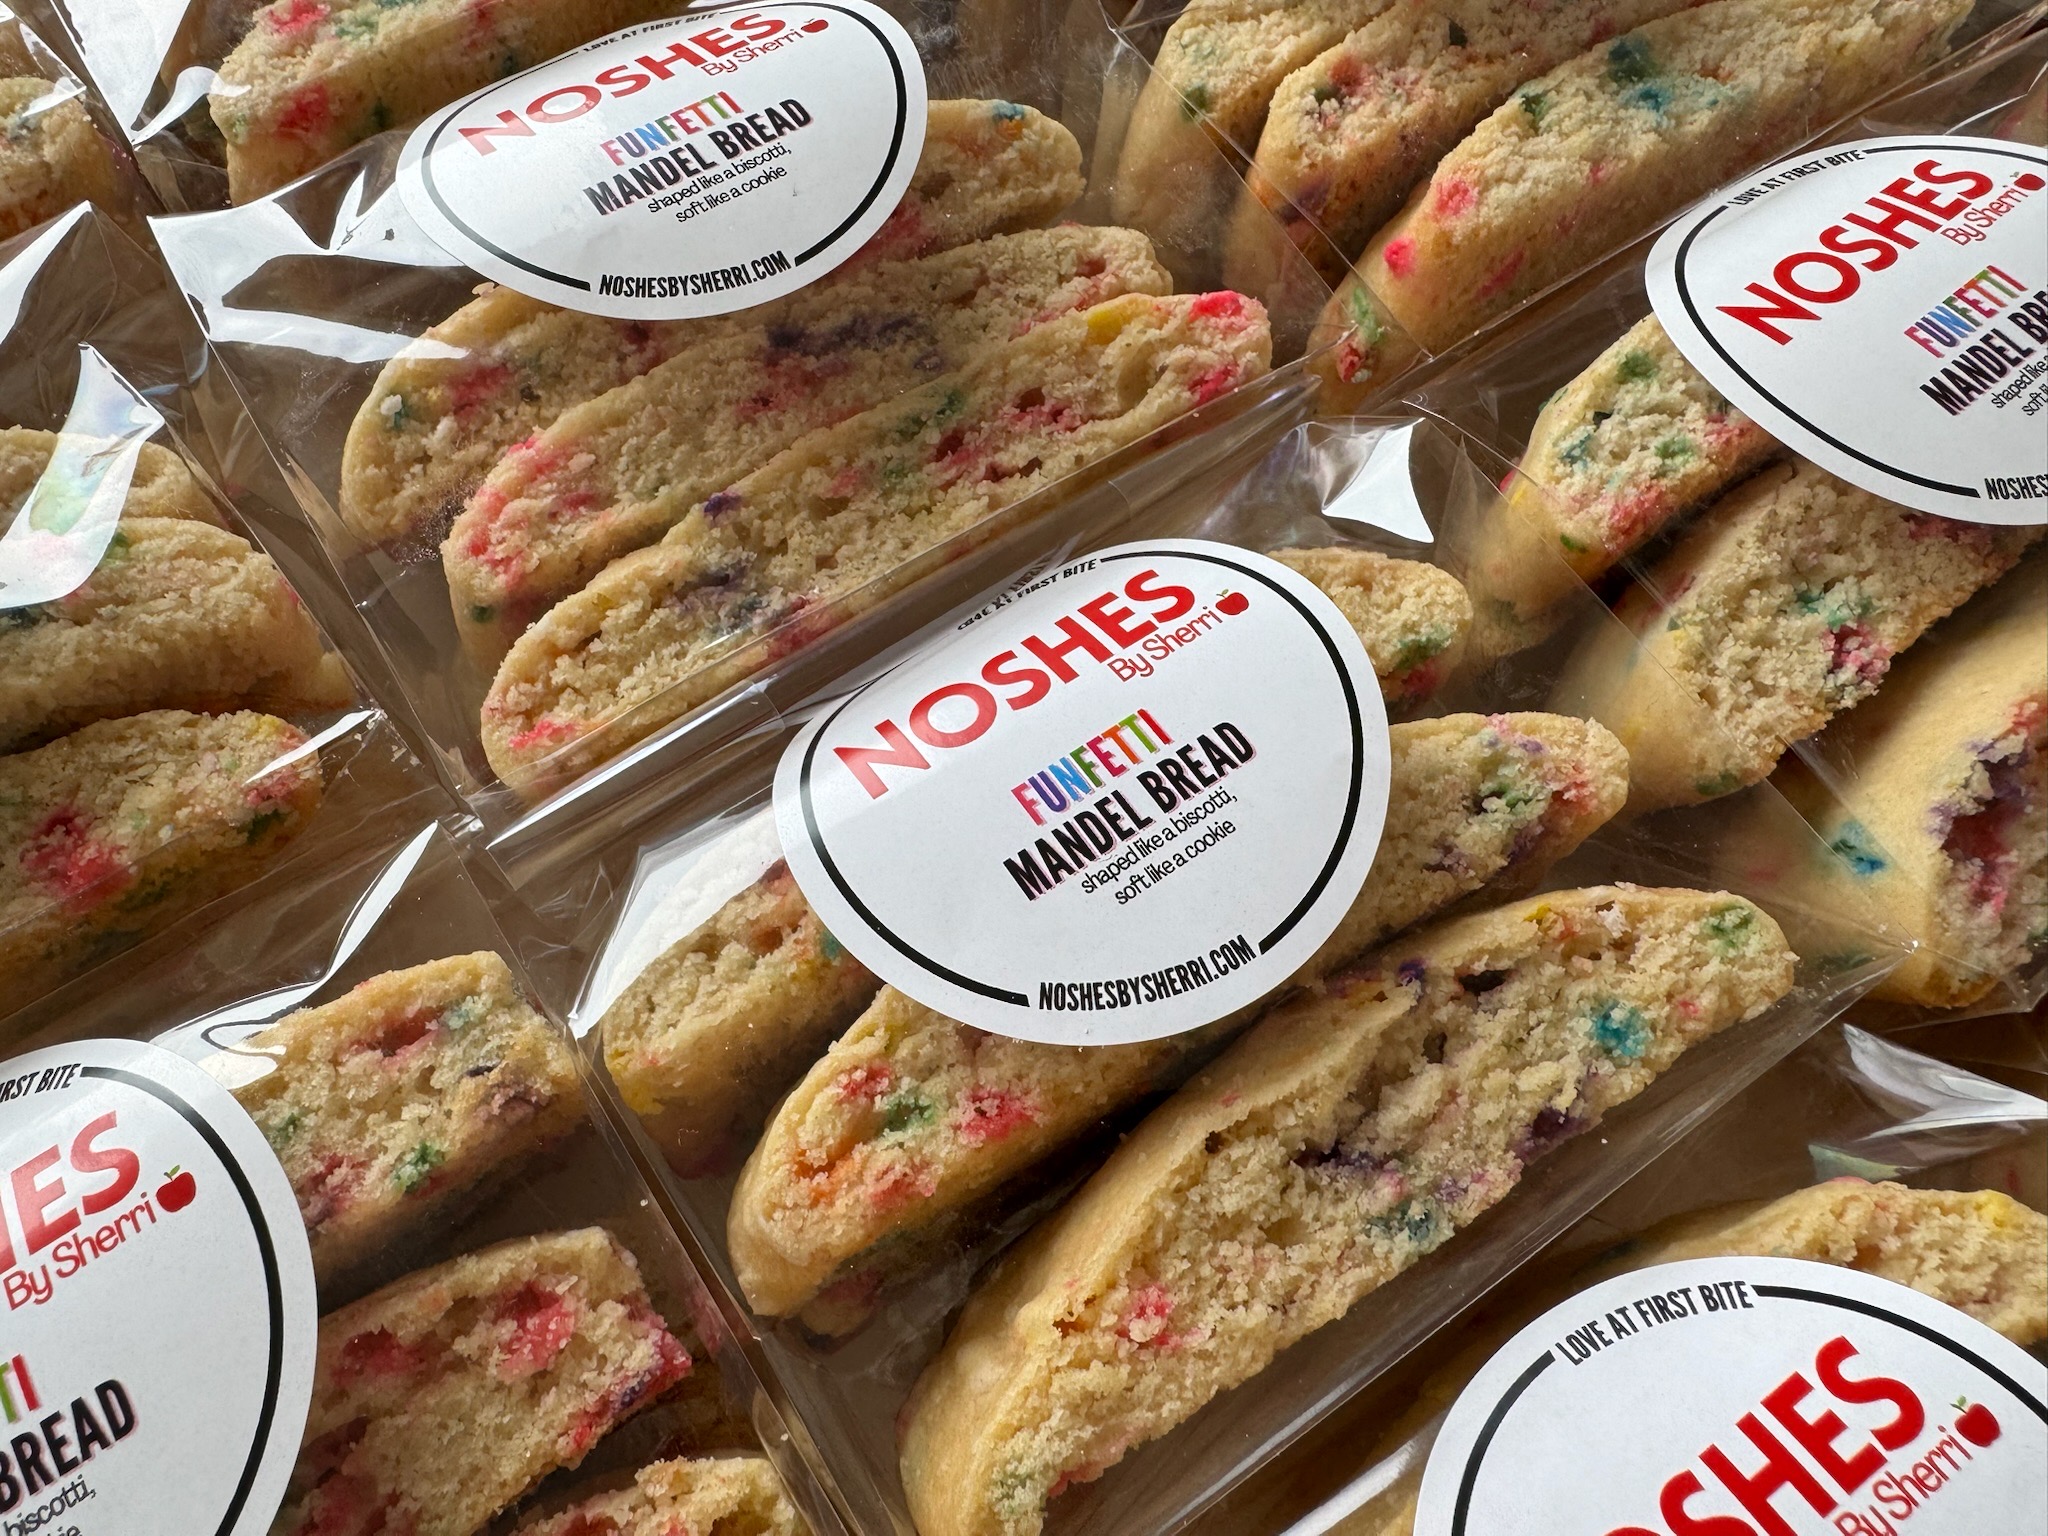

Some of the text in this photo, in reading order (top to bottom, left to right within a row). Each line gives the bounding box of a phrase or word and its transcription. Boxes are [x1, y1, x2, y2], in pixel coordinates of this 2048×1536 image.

[621, 29, 638, 40] AT
[642, 19, 682, 33] FIRST
[685, 12, 718, 24] BITE
[700, 28, 804, 76] By Sherri
[458, 13, 786, 156] NOSHES
[582, 98, 814, 216] MANDEL BREAD
[599, 90, 744, 167] FUNFETTI
[647, 141, 792, 214] shaped like a biscotti,
[675, 165, 788, 223] soft like a cookie
[1727, 149, 1865, 206] LOVE AT FIRST BITE
[1940, 185, 2029, 246] By Sherri
[598, 249, 793, 299] NOSHESBYSHERRI.COM
[1715, 159, 1994, 346] NOSHES
[1903, 264, 2029, 359] FUNFETTI
[1918, 327, 2037, 417] MANDEL
[1991, 369, 2034, 409] shaped
[2021, 391, 2045, 417] soft
[1984, 474, 2048, 500] NOSHES
[1017, 572, 1060, 599] FIRST
[1063, 558, 1098, 580] BITE
[1107, 605, 1224, 683] By Sherri
[833, 568, 1195, 800] NOSHES
[1010, 708, 1175, 827] FUNFETTI
[1002, 721, 1257, 901] MANDEL BREAD
[1080, 785, 1238, 894] shaped like a biscotti,
[1114, 818, 1237, 905] soft like a cookie
[1038, 934, 1257, 1011] NOSHESBYSHERRI.COM
[35, 1063, 81, 1094] BITE
[3, 1191, 157, 1311] By Sherri
[1555, 1280, 1754, 1366] LOVE AT FIRST BITE
[0, 1379, 139, 1515] BREAD
[1833, 1424, 1974, 1536] By Sherri
[3, 1473, 97, 1536] biscotti,
